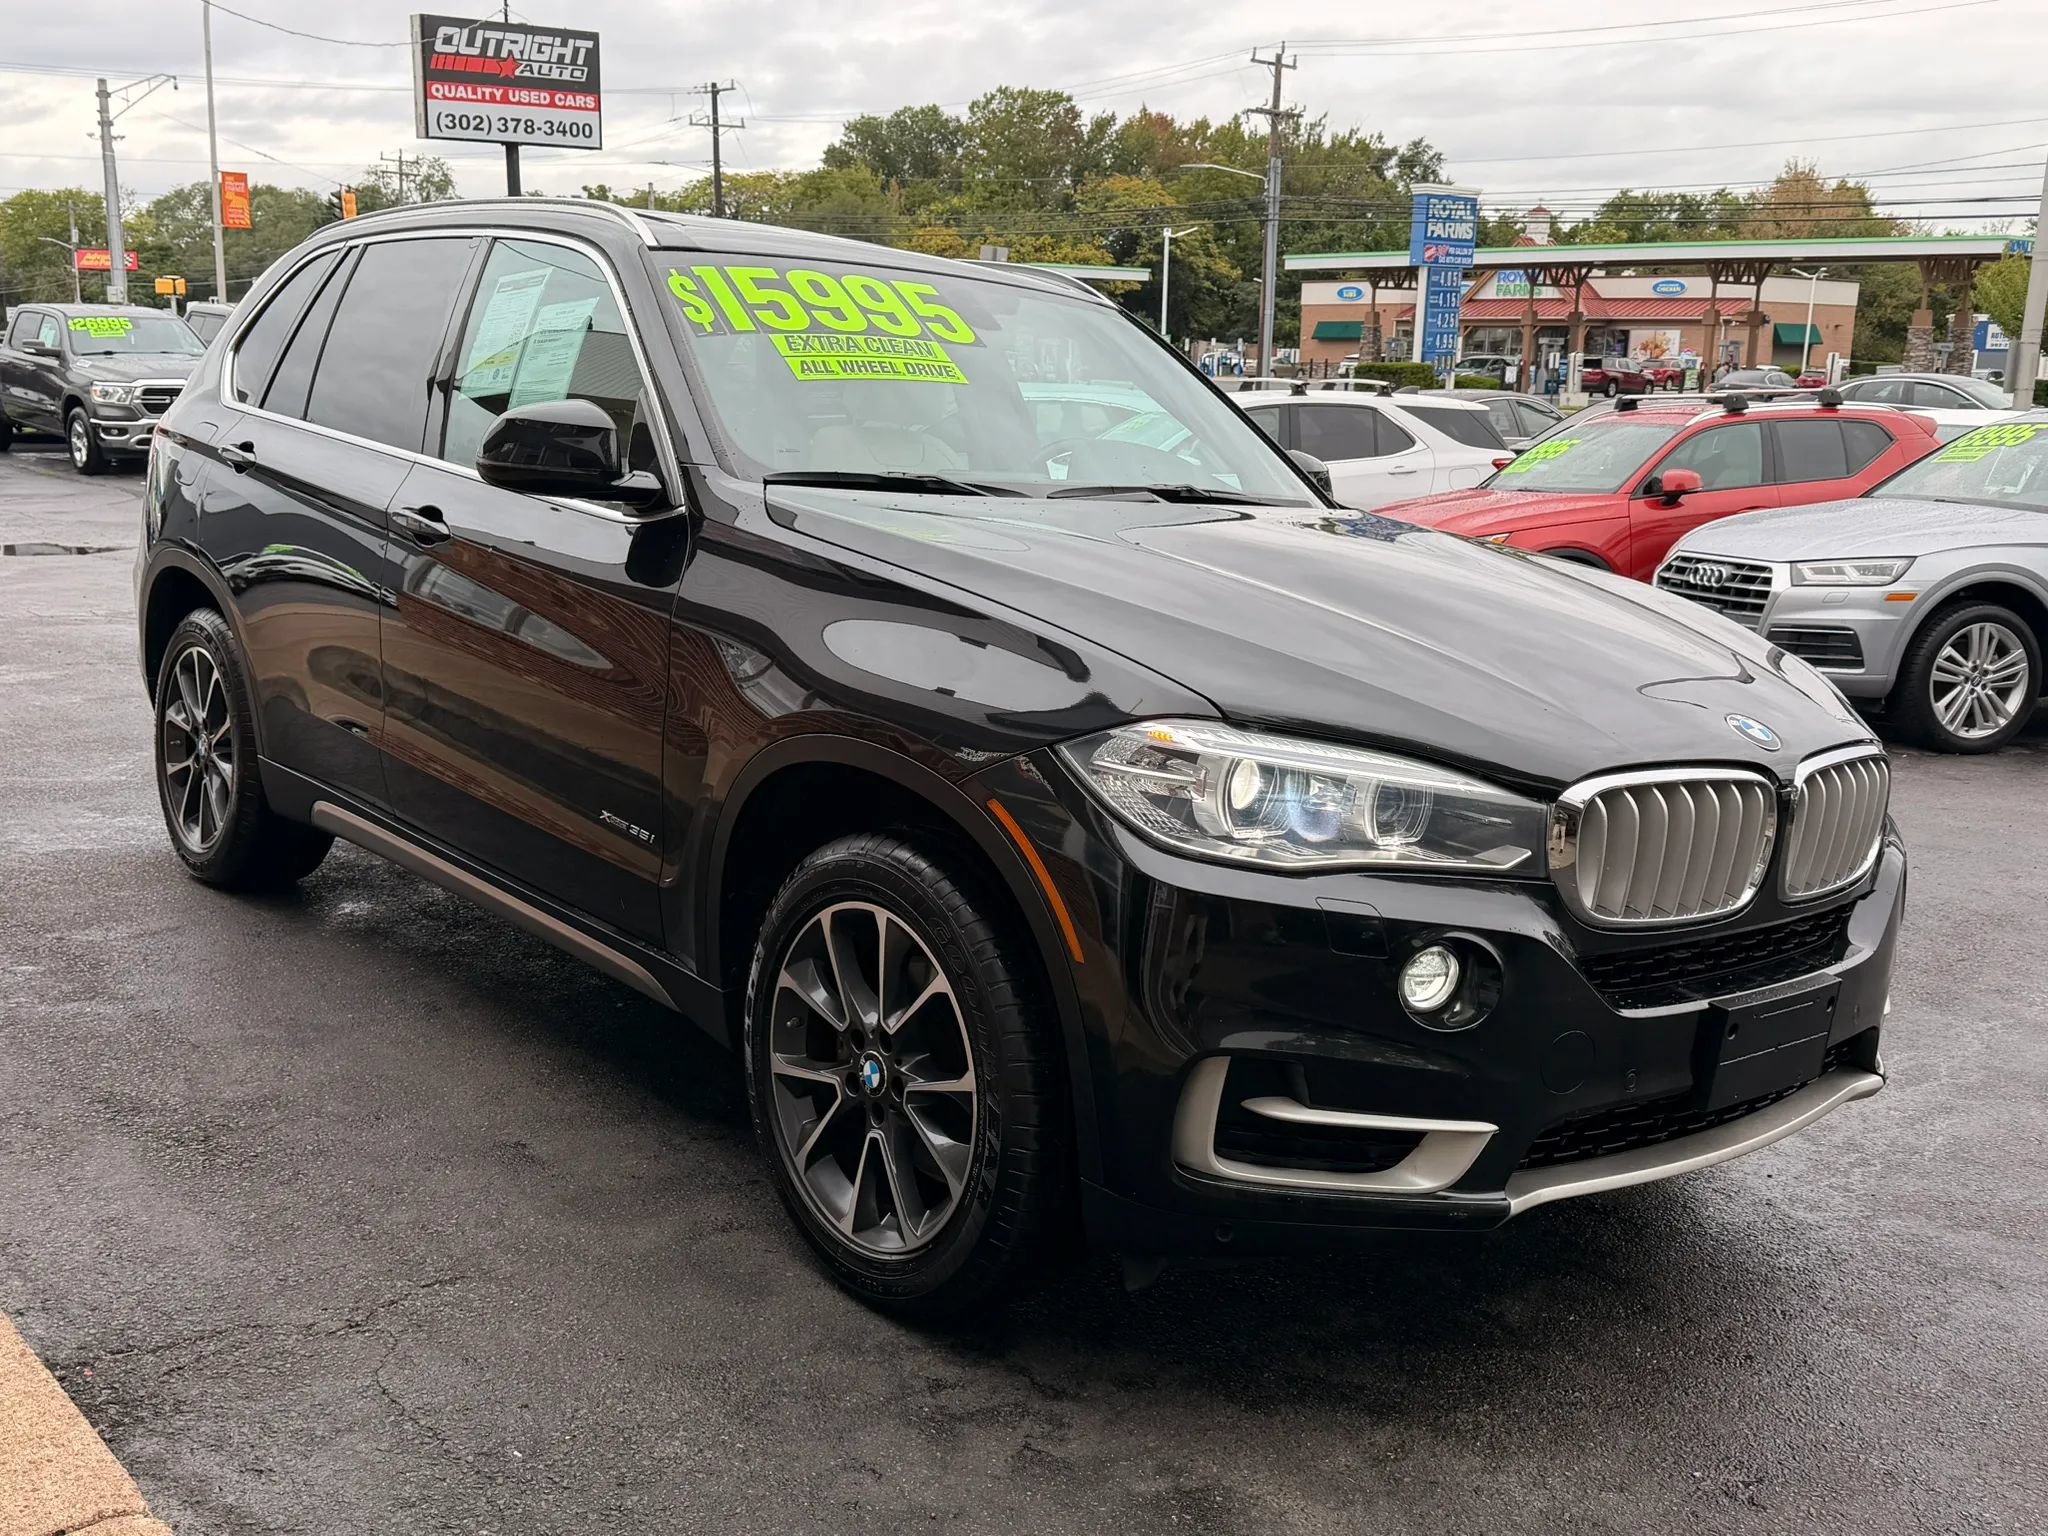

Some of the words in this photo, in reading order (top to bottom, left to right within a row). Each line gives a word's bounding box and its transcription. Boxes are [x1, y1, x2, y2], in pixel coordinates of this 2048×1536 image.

[434, 26, 594, 65] OUTRIGHT
[519, 63, 587, 80] AUTO
[431, 84, 503, 101] QUALITY
[508, 90, 551, 105] USED
[555, 94, 596, 109] CARS
[436, 112, 492, 136] (302)
[497, 116, 593, 139] 378-3400
[1428, 198, 1474, 219] ROYAL
[1427, 219, 1474, 239] FARMS
[668, 266, 976, 344] $15995
[787, 335, 864, 355] EXTRA
[864, 338, 935, 358] CLEAN
[800, 360, 835, 376] ALL
[840, 360, 902, 377] WHEEL
[908, 364, 957, 380] DRIVE
